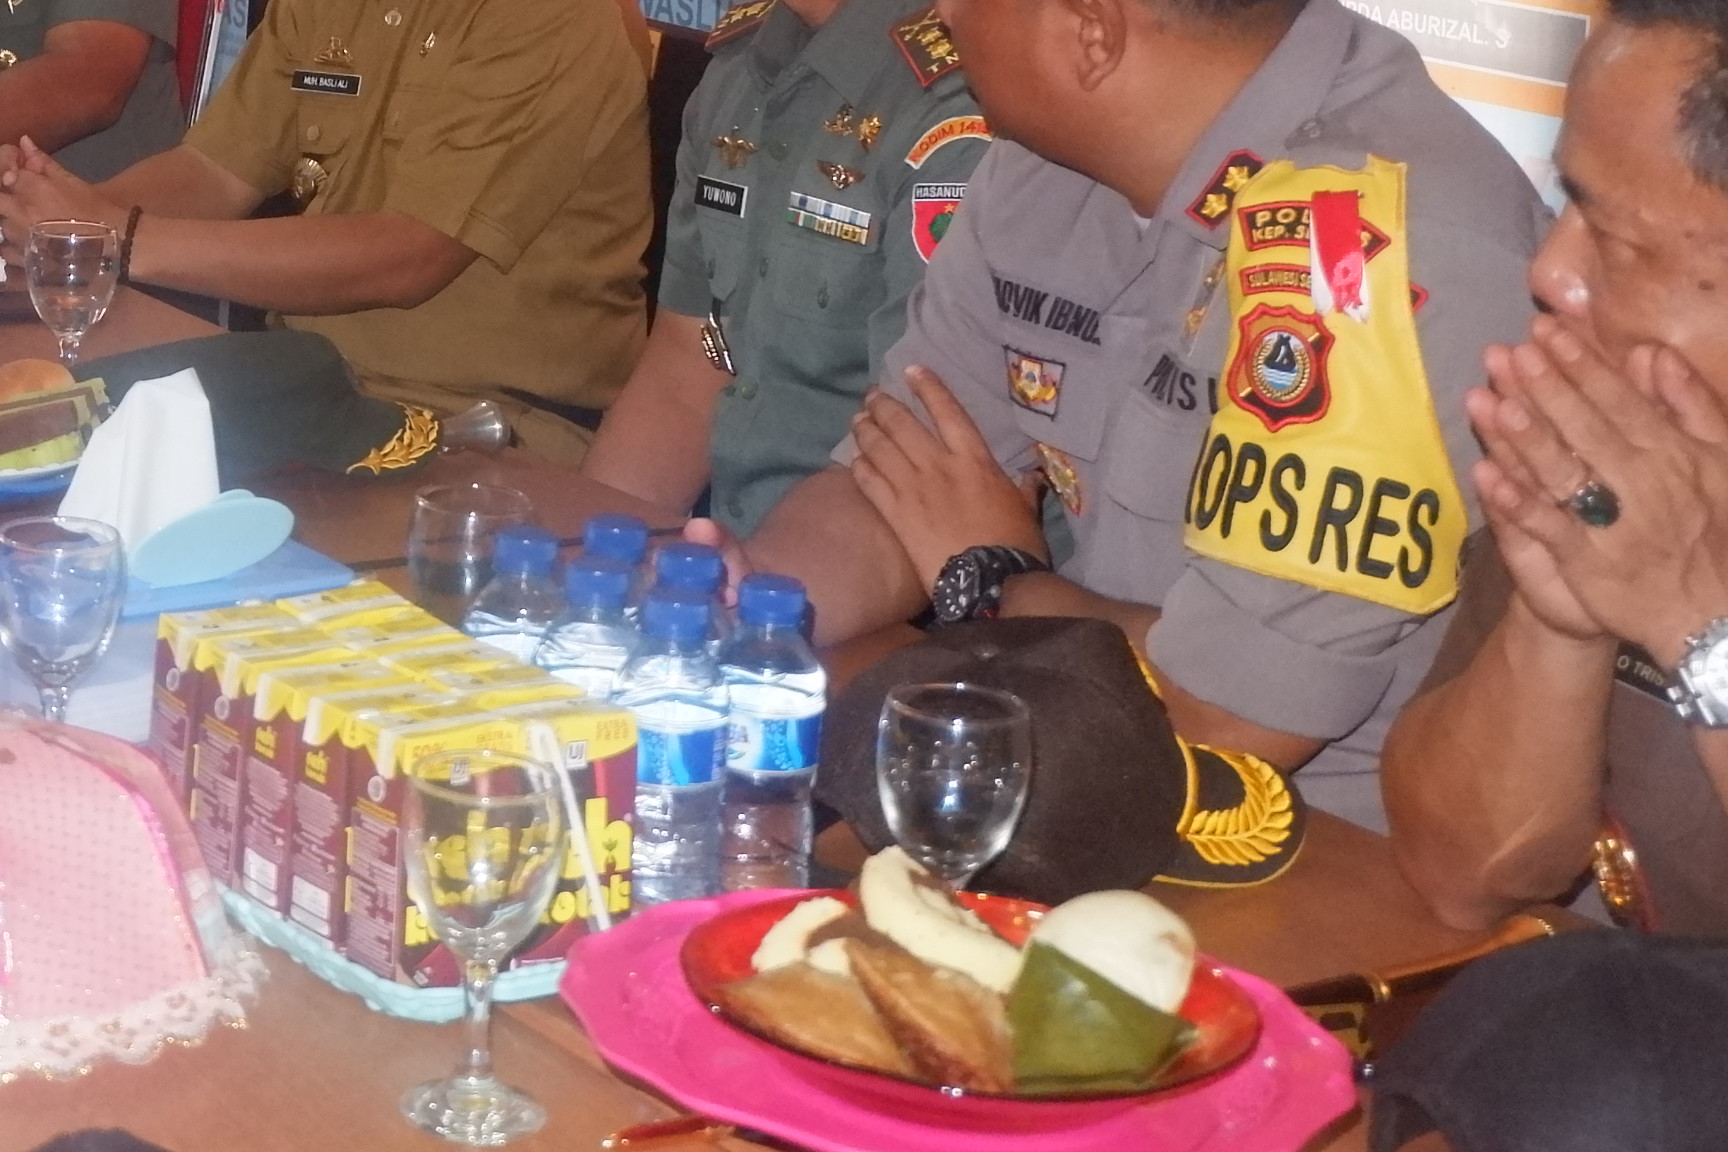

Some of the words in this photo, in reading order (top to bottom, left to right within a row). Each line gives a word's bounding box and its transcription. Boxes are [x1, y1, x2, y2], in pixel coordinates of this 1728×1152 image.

[703, 183, 737, 208] YUWONO
[916, 186, 966, 198] HASANUD
[1255, 208, 1310, 227] POL
[1186, 431, 1306, 553] OPS
[1309, 466, 1440, 590] RES
